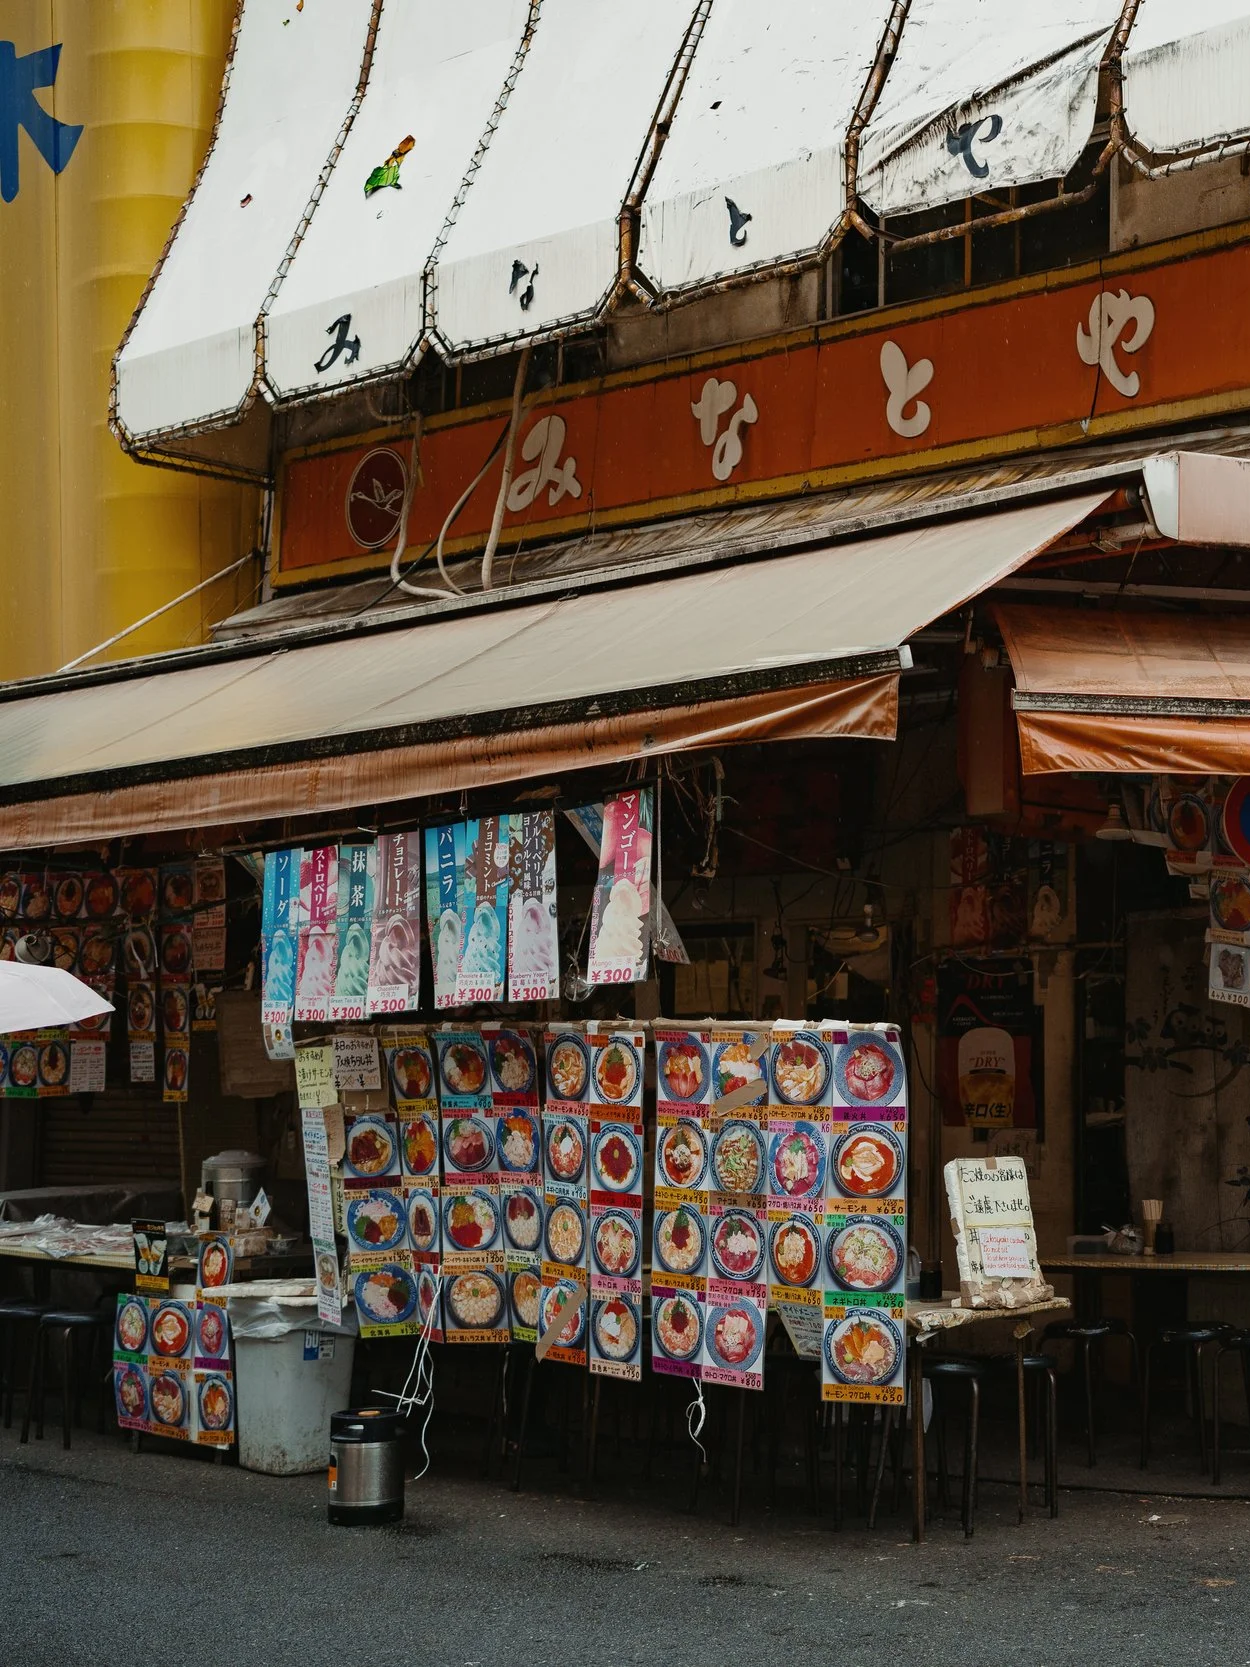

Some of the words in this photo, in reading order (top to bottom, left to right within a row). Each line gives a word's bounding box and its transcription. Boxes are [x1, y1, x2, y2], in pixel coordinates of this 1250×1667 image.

[505, 288, 1156, 514] みなとや
[620, 793, 637, 870] マンゴー
[484, 816, 495, 893] チョコミント
[523, 816, 532, 890] ヨーグルト風味
[532, 812, 543, 889] ブルーベリー
[439, 828, 454, 895] バニラ
[391, 833, 405, 907] チョコレート
[313, 849, 326, 919] ストロベリー
[350, 850, 366, 908] 抹茶
[278, 855, 290, 919] ソーダ
[591, 967, 632, 983] ¥300
[458, 988, 492, 1001] ¥300
[512, 986, 547, 1000] ¥300
[370, 998, 406, 1013] ¥300
[264, 1010, 286, 1023] ¥300
[297, 1008, 326, 1021] ¥300
[331, 1006, 362, 1019] ¥300
[822, 1031, 832, 1042] K5
[334, 1038, 375, 1053] 本日のおすすめ!
[298, 1048, 324, 1063] おすすめ!
[808, 1113, 830, 1121] ¥650
[879, 1112, 905, 1121] ¥650
[821, 1122, 831, 1133] K6
[894, 1122, 905, 1132] K2
[717, 1197, 738, 1205] アナゴ丼
[747, 1200, 767, 1209] ¥650
[803, 1204, 824, 1213] ¥650
[755, 1209, 767, 1220] K10
[834, 1205, 867, 1213] サーモン丼
[877, 1206, 904, 1215] ¥650
[893, 1215, 905, 1226] K3
[597, 1281, 617, 1290] 中トロ丼
[686, 1282, 705, 1291] ¥850
[709, 1285, 743, 1295] カニ・マグロ丼
[746, 1289, 766, 1299] ¥750
[803, 1296, 821, 1305] ¥650
[832, 1298, 867, 1306] ネギトロ丼
[782, 1304, 821, 1316] サイドメニュー
[892, 1308, 903, 1319] K4
[704, 1371, 737, 1382] 中トロ・マグロ丼
[740, 1377, 761, 1387] ¥800
[825, 1391, 871, 1399] サーモン・マグロ丼
[875, 1394, 903, 1402] ¥650
